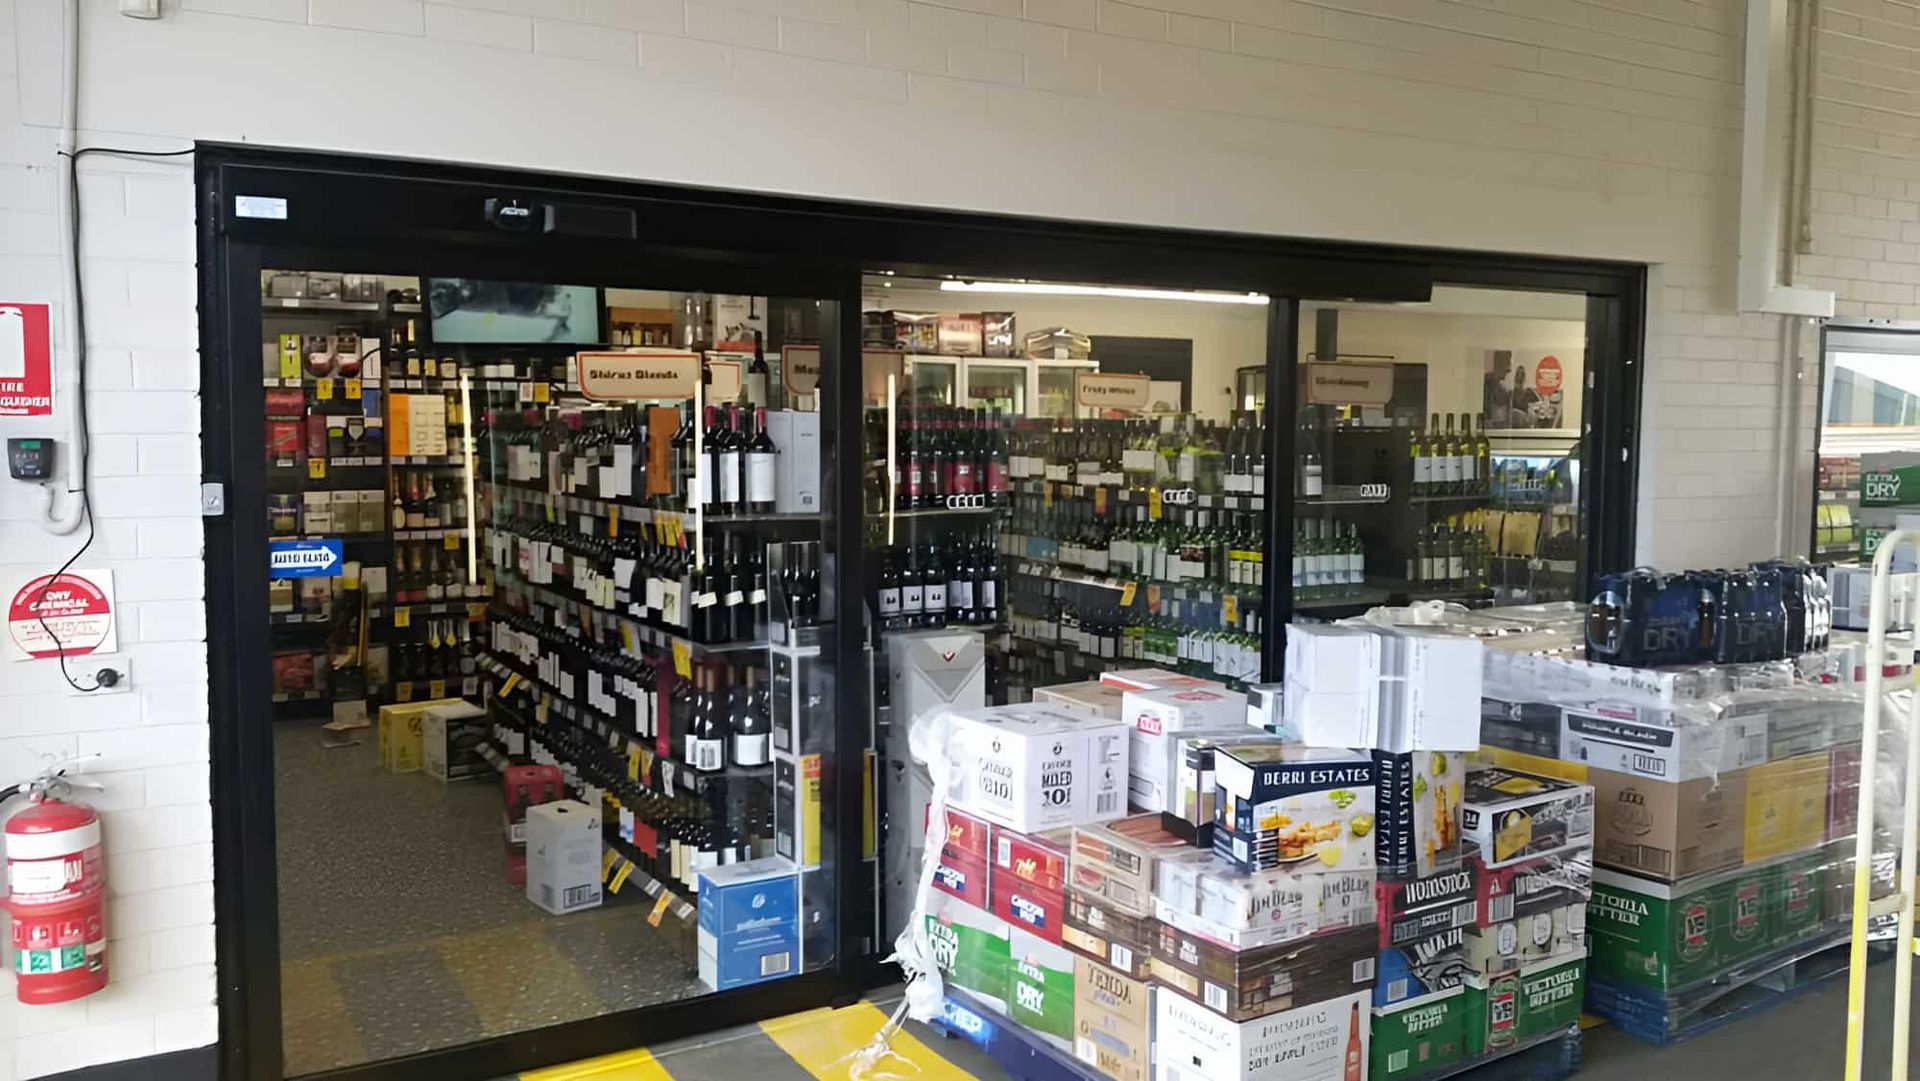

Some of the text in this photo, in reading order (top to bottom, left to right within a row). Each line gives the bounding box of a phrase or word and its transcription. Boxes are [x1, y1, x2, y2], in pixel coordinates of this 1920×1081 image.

[1866, 482, 1900, 497] DRY
[1263, 768, 1370, 786] BERRI ESTATES
[1379, 809, 1391, 863] ESTATES
